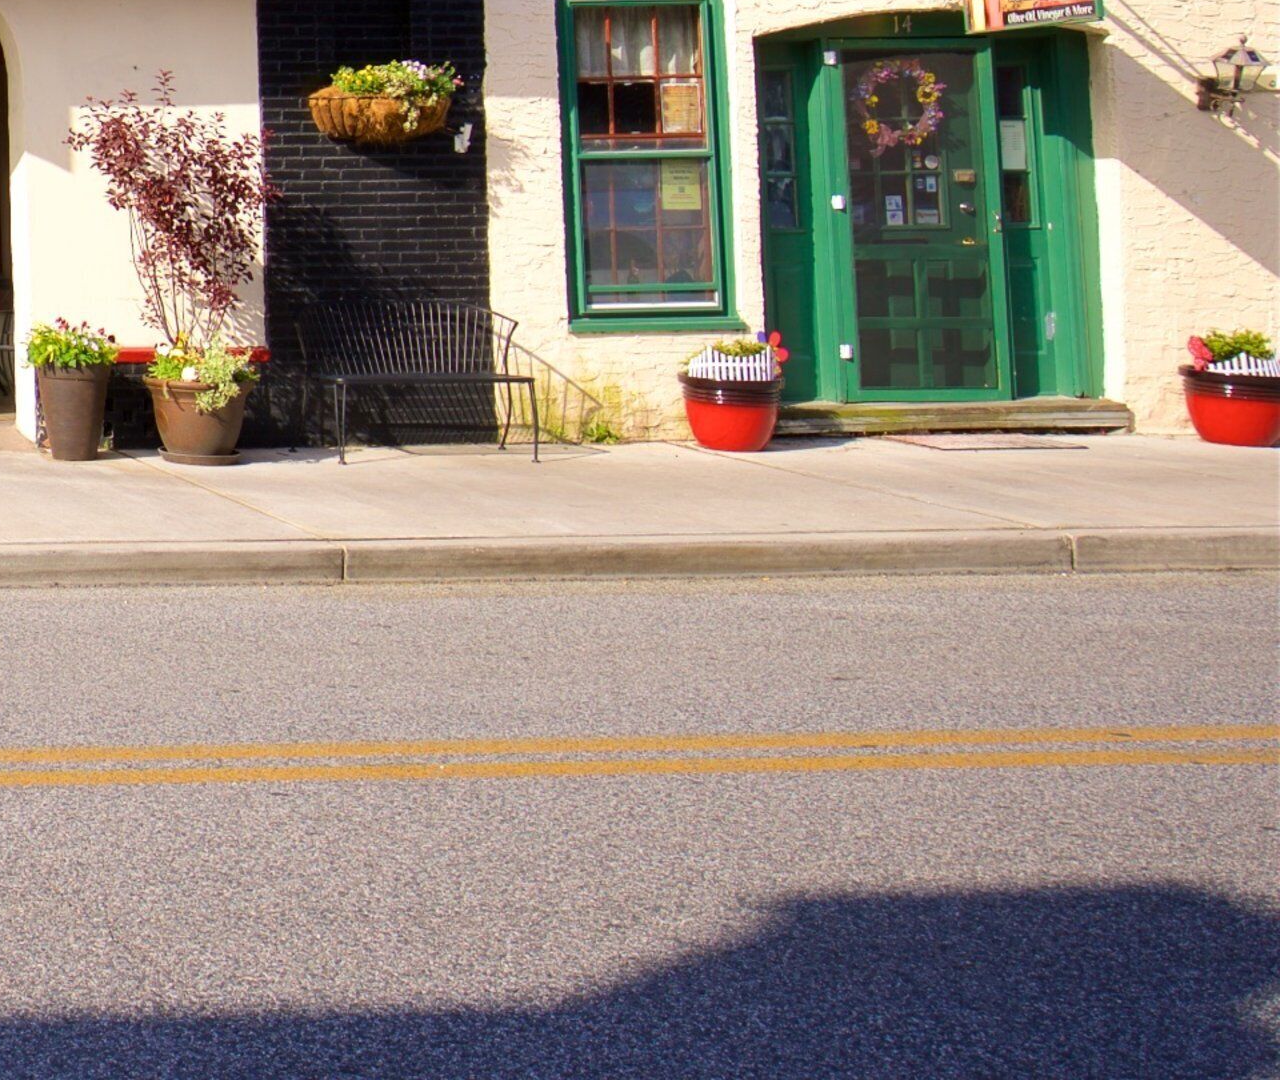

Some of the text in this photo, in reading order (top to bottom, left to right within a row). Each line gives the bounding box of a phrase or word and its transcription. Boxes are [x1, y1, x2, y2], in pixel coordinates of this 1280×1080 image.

[1037, 8, 1064, 21] Vinegar
[1065, 7, 1072, 17] &
[1072, 5, 1093, 16] More
[893, 15, 912, 34] 14
